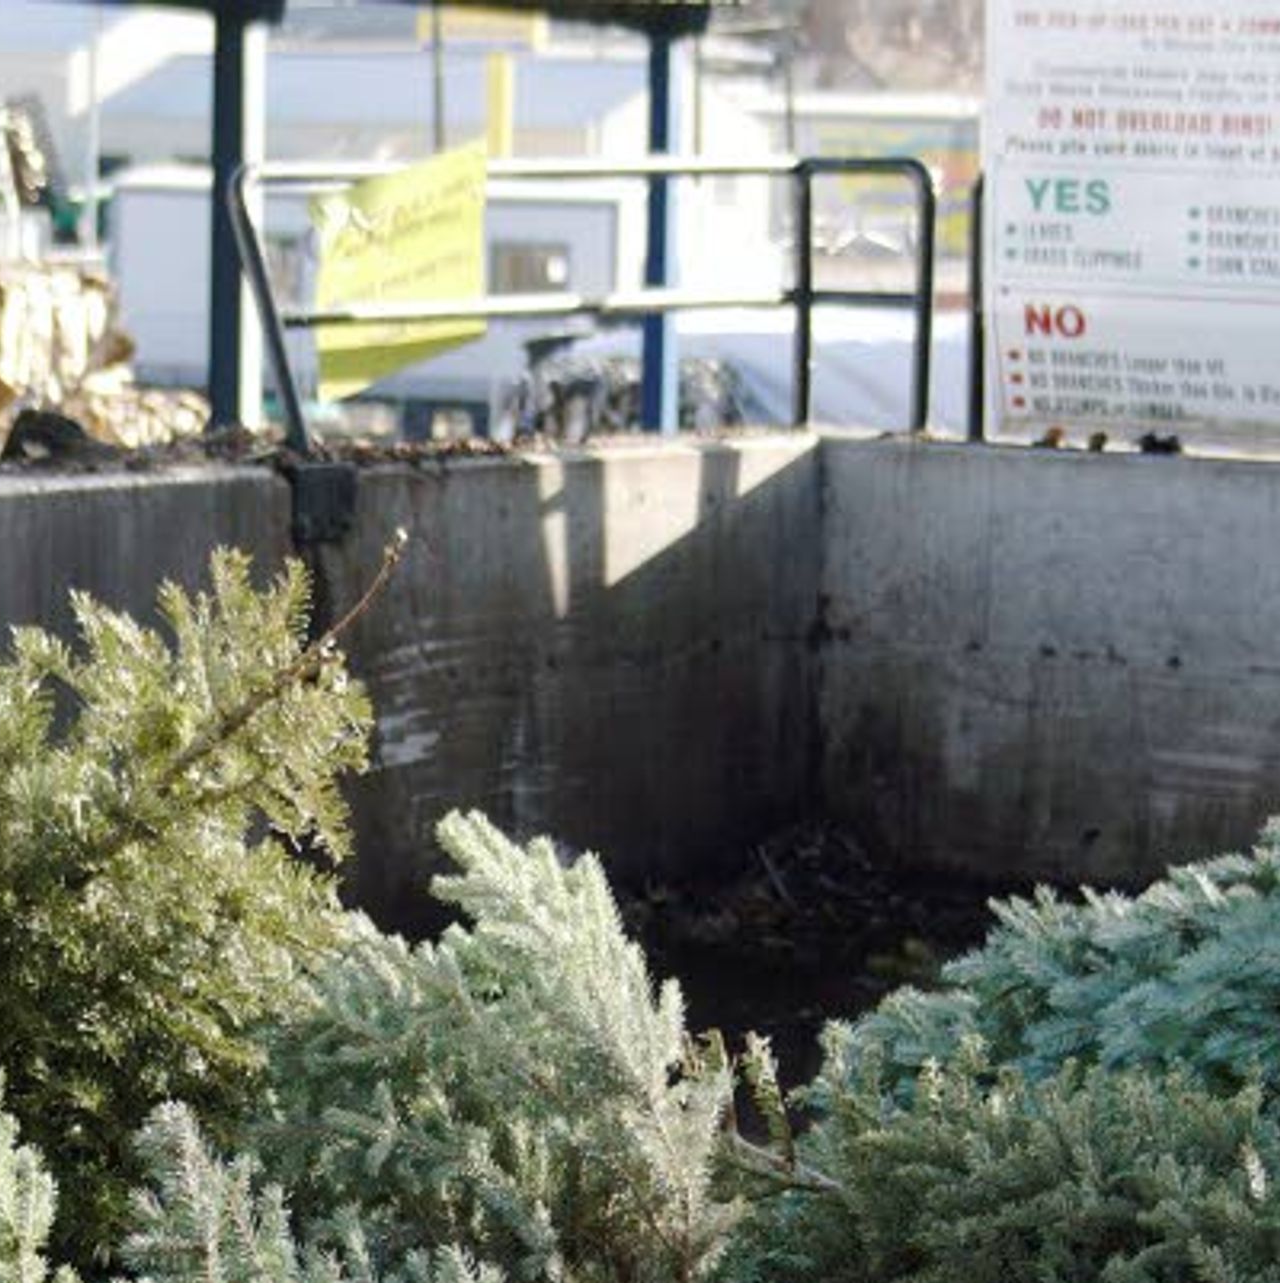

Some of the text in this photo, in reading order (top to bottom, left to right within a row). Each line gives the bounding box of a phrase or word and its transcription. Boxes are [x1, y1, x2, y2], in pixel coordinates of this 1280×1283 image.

[1038, 107, 1062, 130] DO
[1072, 107, 1106, 131] NOT
[1117, 109, 1211, 135] OVERLOAD
[1025, 178, 1111, 215] YES
[1024, 304, 1086, 338] NO
